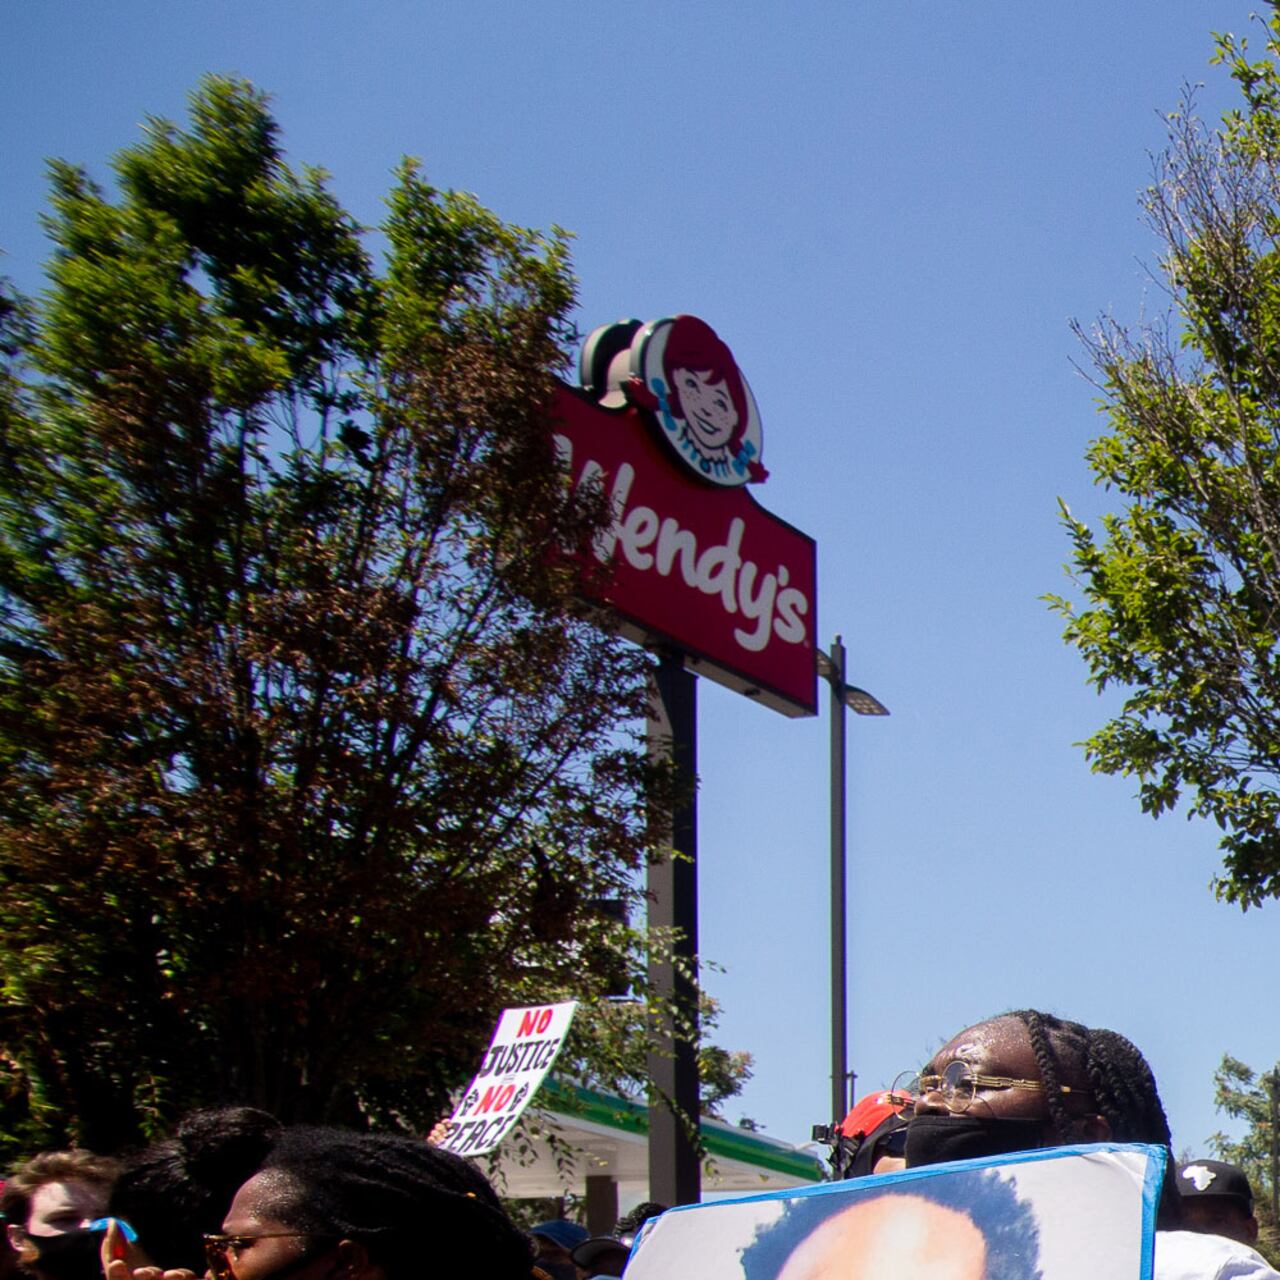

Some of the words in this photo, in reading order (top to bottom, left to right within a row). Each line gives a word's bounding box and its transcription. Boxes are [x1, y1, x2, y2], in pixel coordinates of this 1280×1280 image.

[516, 1008, 554, 1038] NO
[478, 1037, 562, 1079] JUSTICE
[473, 1083, 517, 1117] NO
